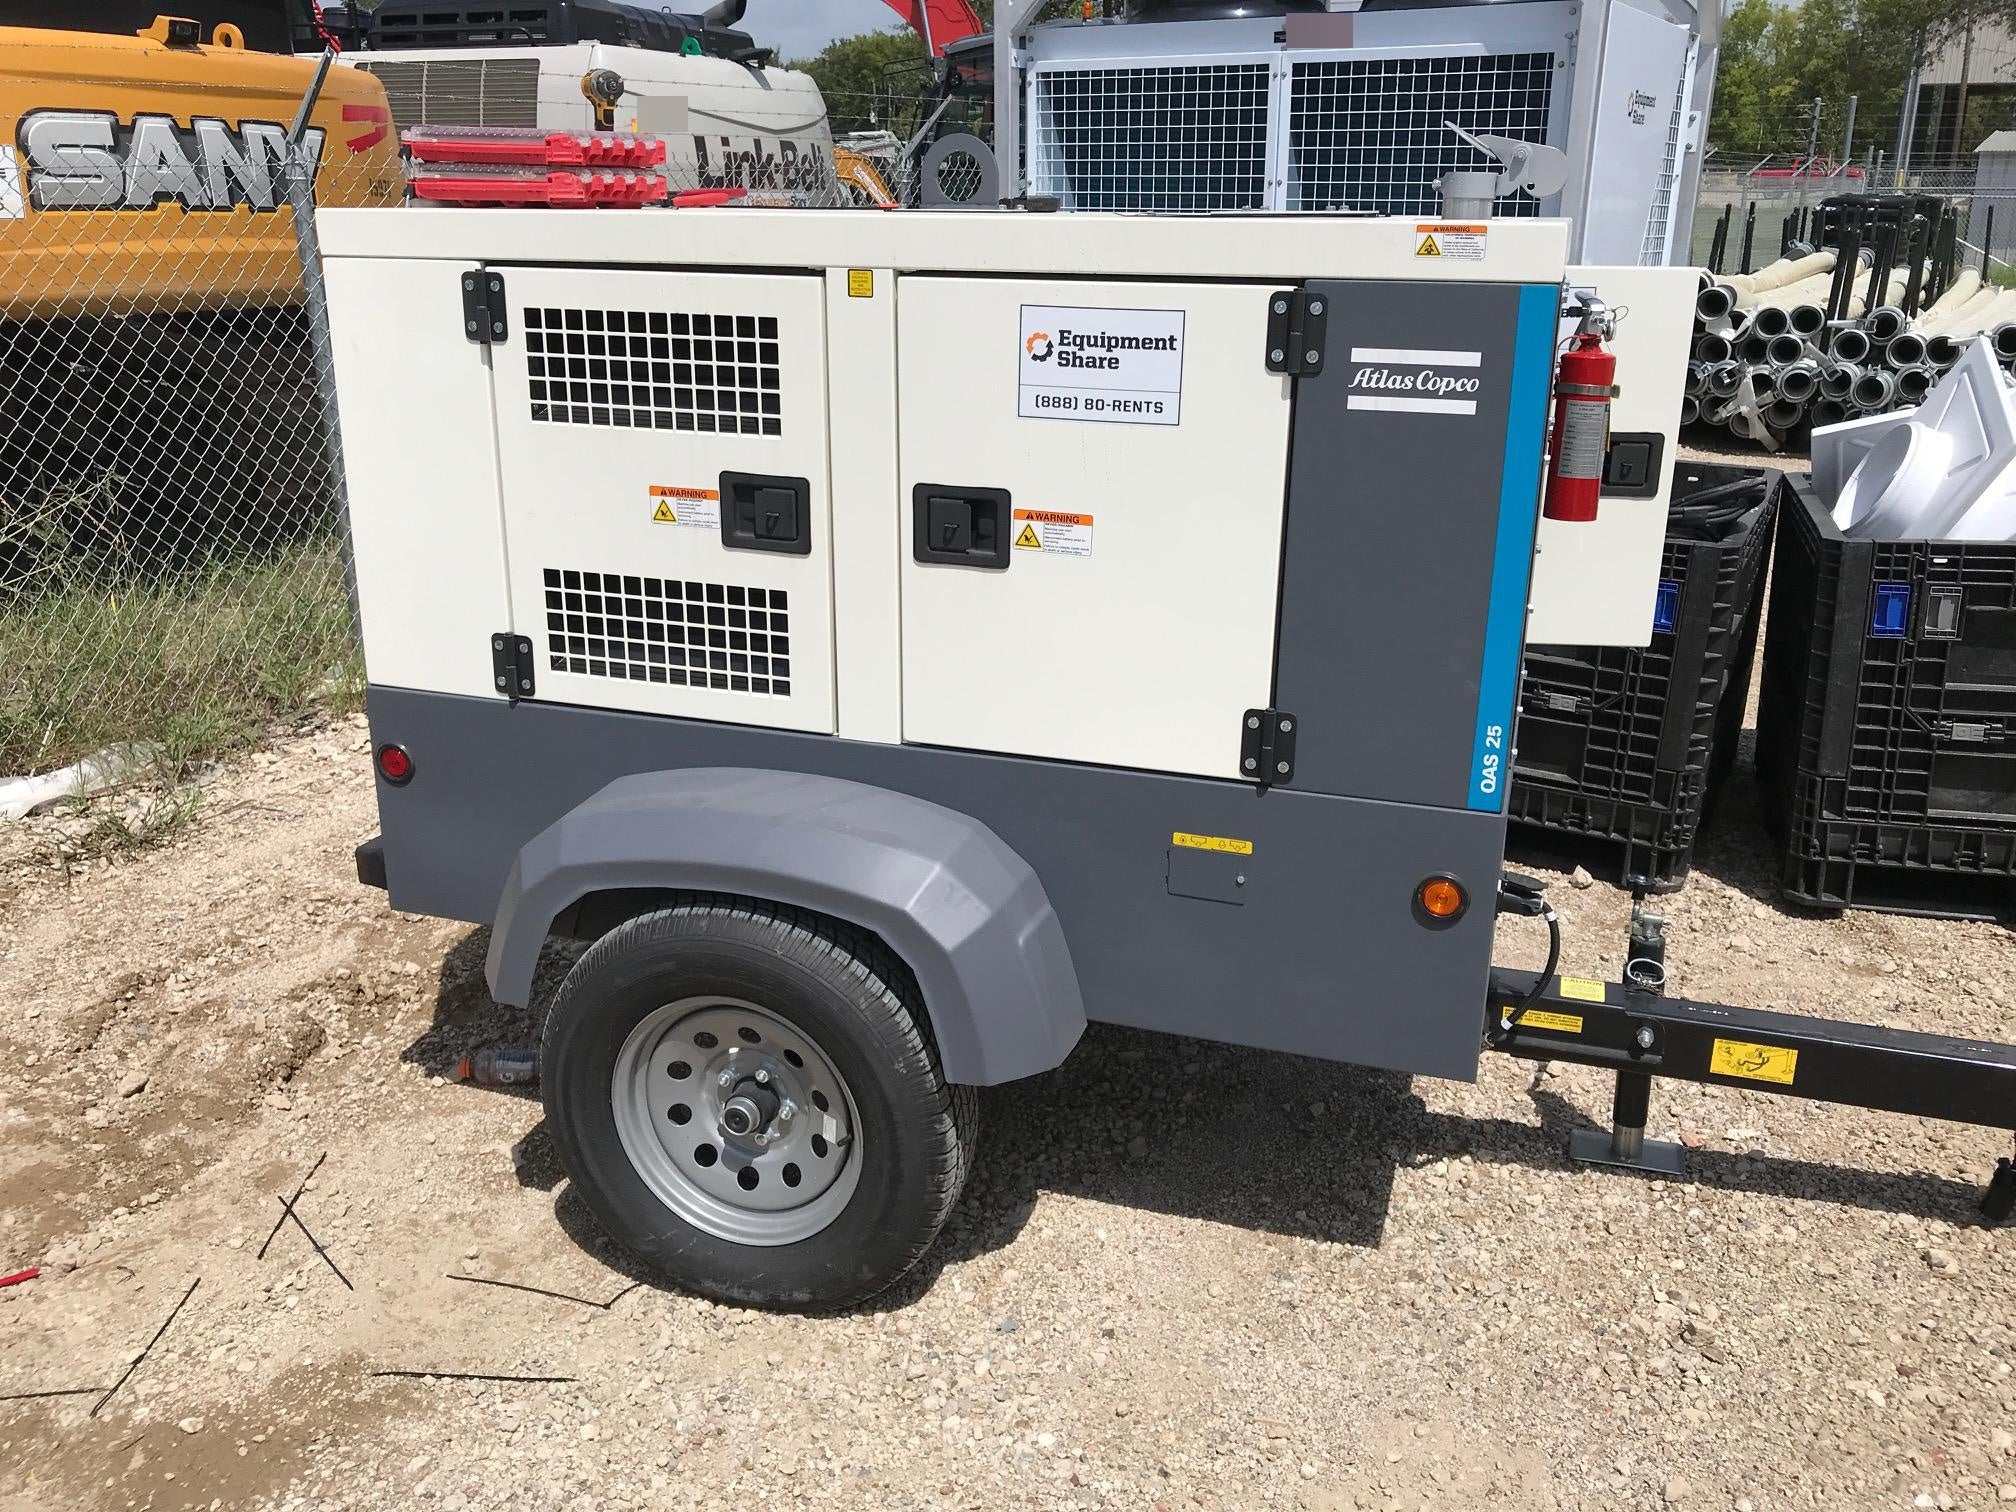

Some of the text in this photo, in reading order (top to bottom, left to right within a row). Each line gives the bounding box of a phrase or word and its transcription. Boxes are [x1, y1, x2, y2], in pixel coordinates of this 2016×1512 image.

[1634, 90, 1656, 109] Equipment
[1058, 329, 1178, 353] Equipment
[1057, 350, 1120, 370] Share
[1347, 367, 1480, 396] Atlas Copco
[1035, 394, 1164, 414] (888) 80-RENTS
[668, 488, 708, 499] WARNING
[1035, 512, 1080, 524] WARNING
[1485, 725, 1503, 749] 25
